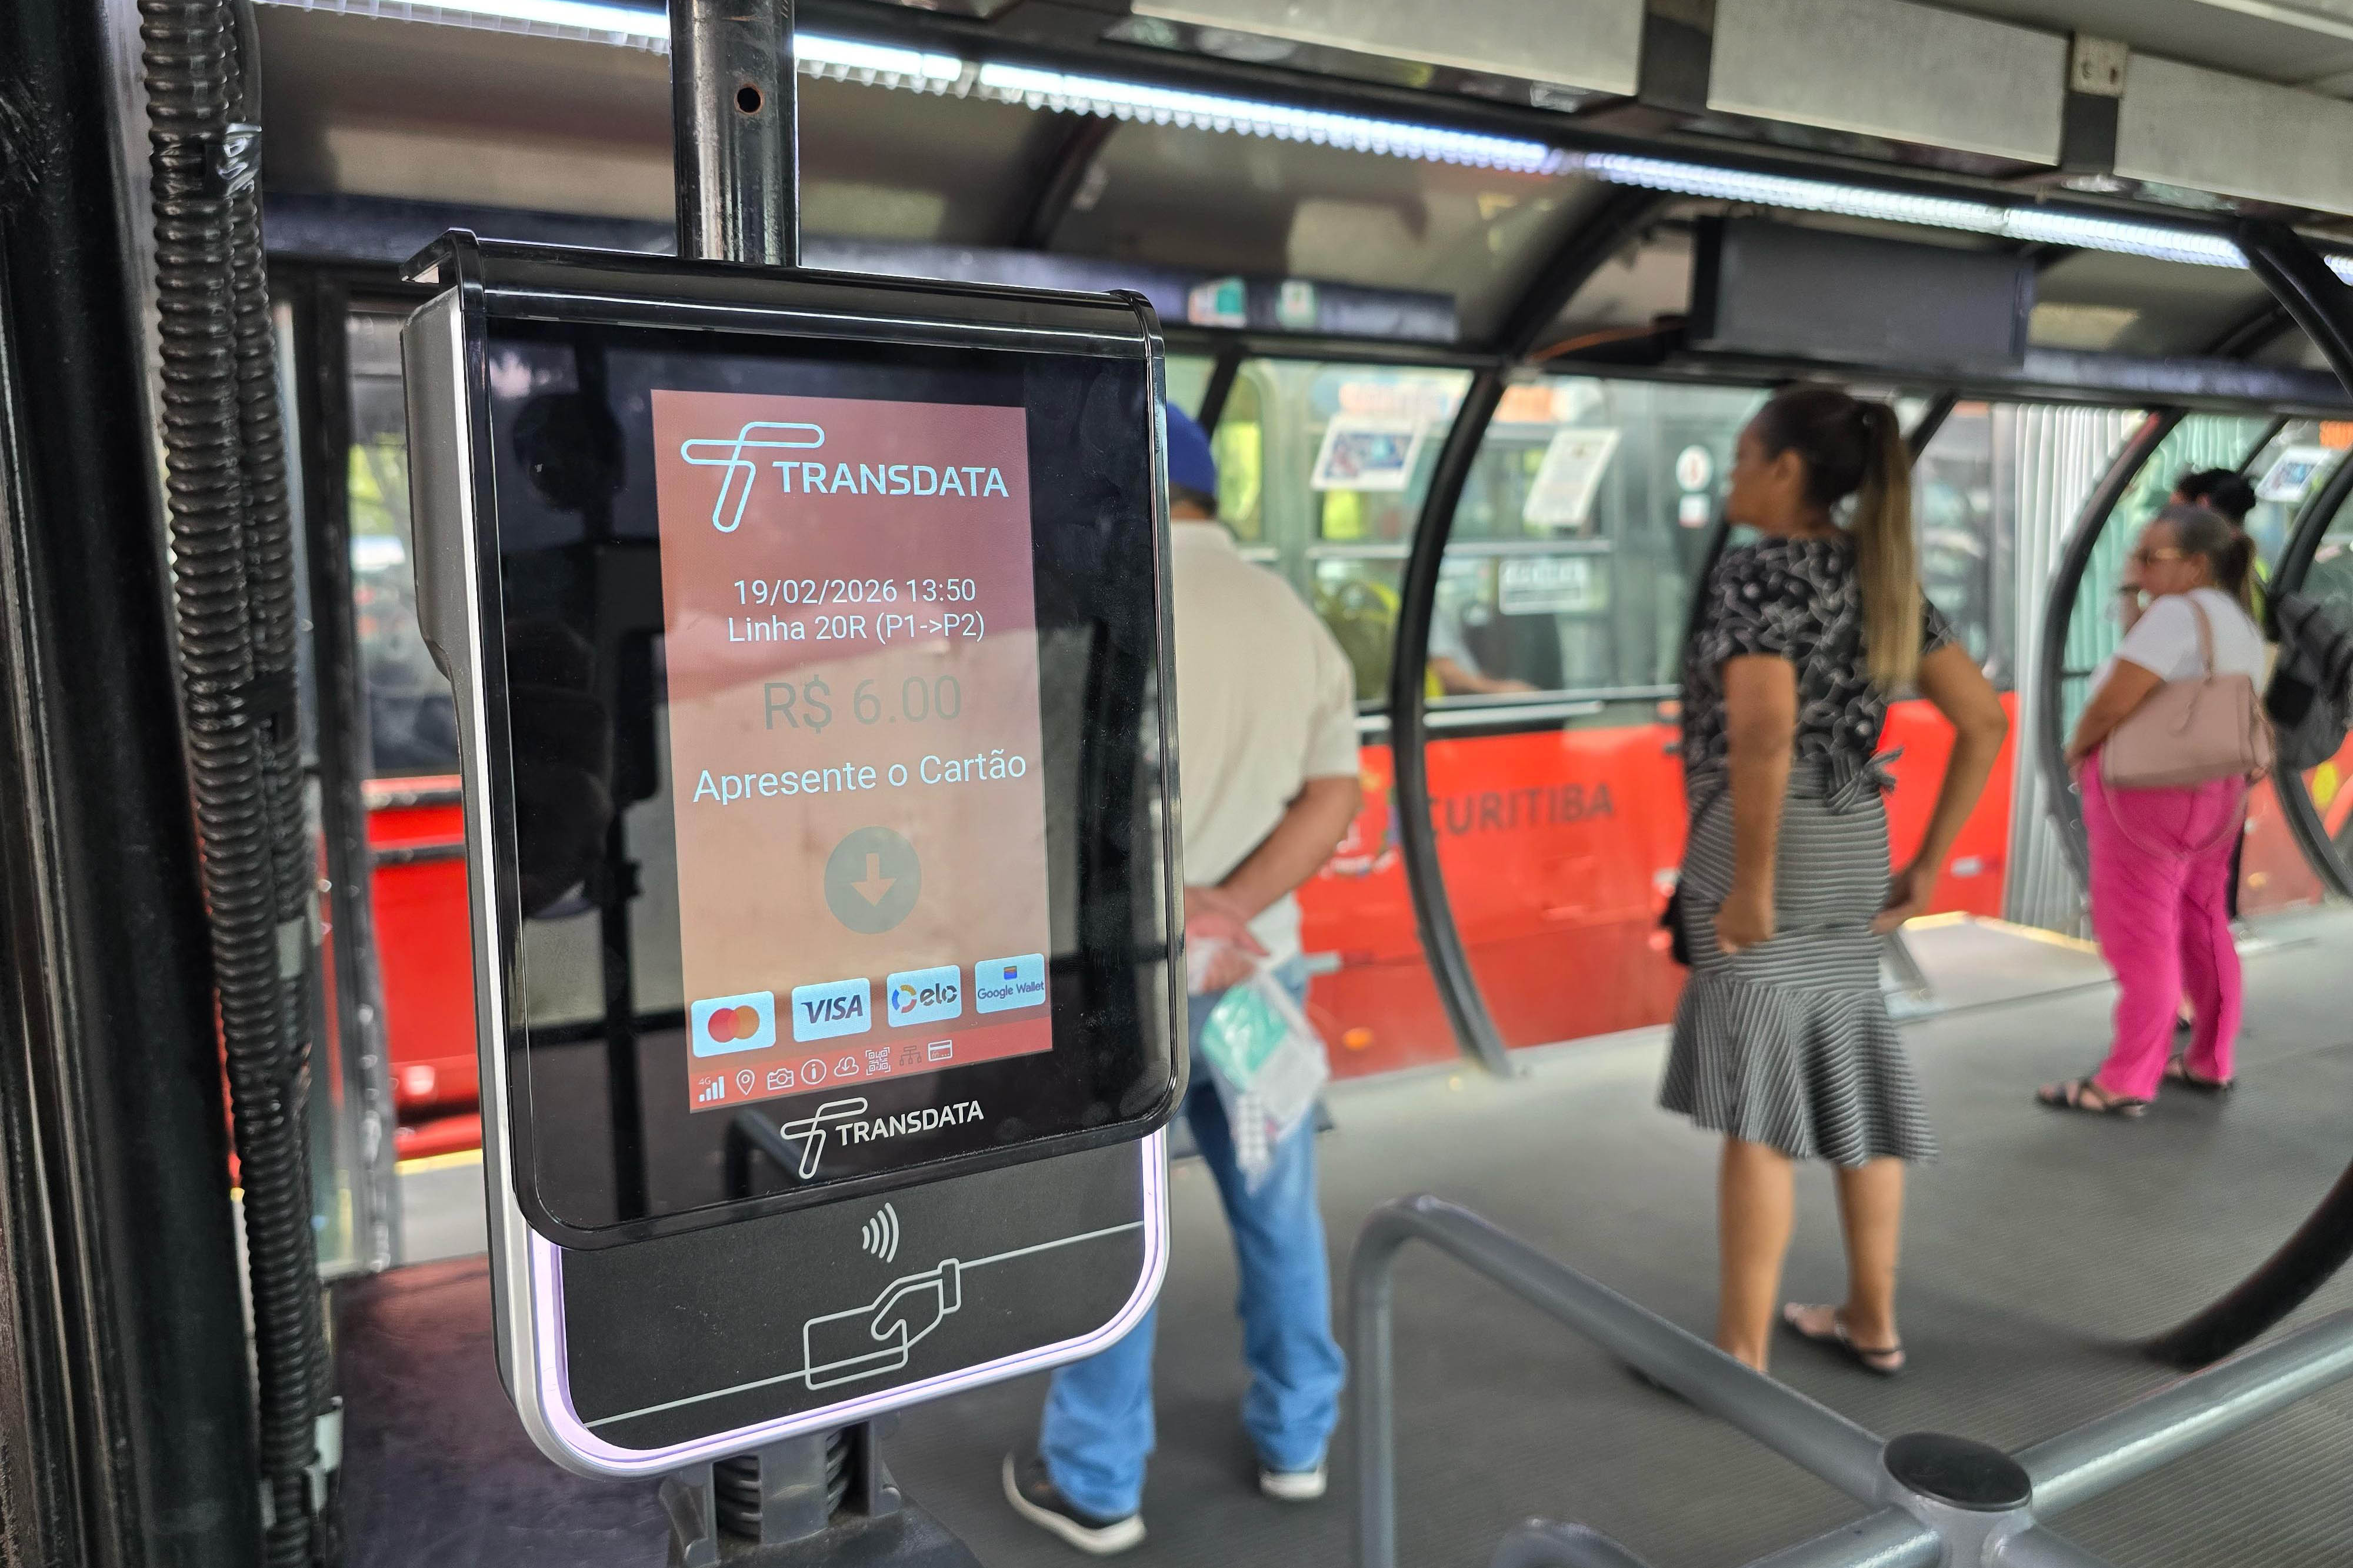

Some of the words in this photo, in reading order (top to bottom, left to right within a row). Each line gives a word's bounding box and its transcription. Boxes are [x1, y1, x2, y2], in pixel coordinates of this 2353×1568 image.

[772, 461, 1009, 498] TRANSDATA
[734, 579, 898, 606] 19/02/2026
[906, 578, 976, 603] 13:50
[728, 615, 806, 642] Linha
[815, 615, 868, 640] 20R
[876, 610, 985, 645] (P1->P2)
[764, 674, 832, 734] R$
[854, 675, 961, 725] 6.00
[692, 762, 876, 805] Apresente
[888, 763, 908, 787] o
[920, 749, 1026, 785] Cartão
[1429, 782, 1613, 836] URITIBA
[919, 983, 958, 1006] elo
[977, 984, 1014, 999] Google
[1016, 980, 1045, 994] Wallet
[801, 994, 864, 1025] VISA
[698, 1076, 711, 1086] 4G
[835, 1100, 984, 1146] TRANSDATA
